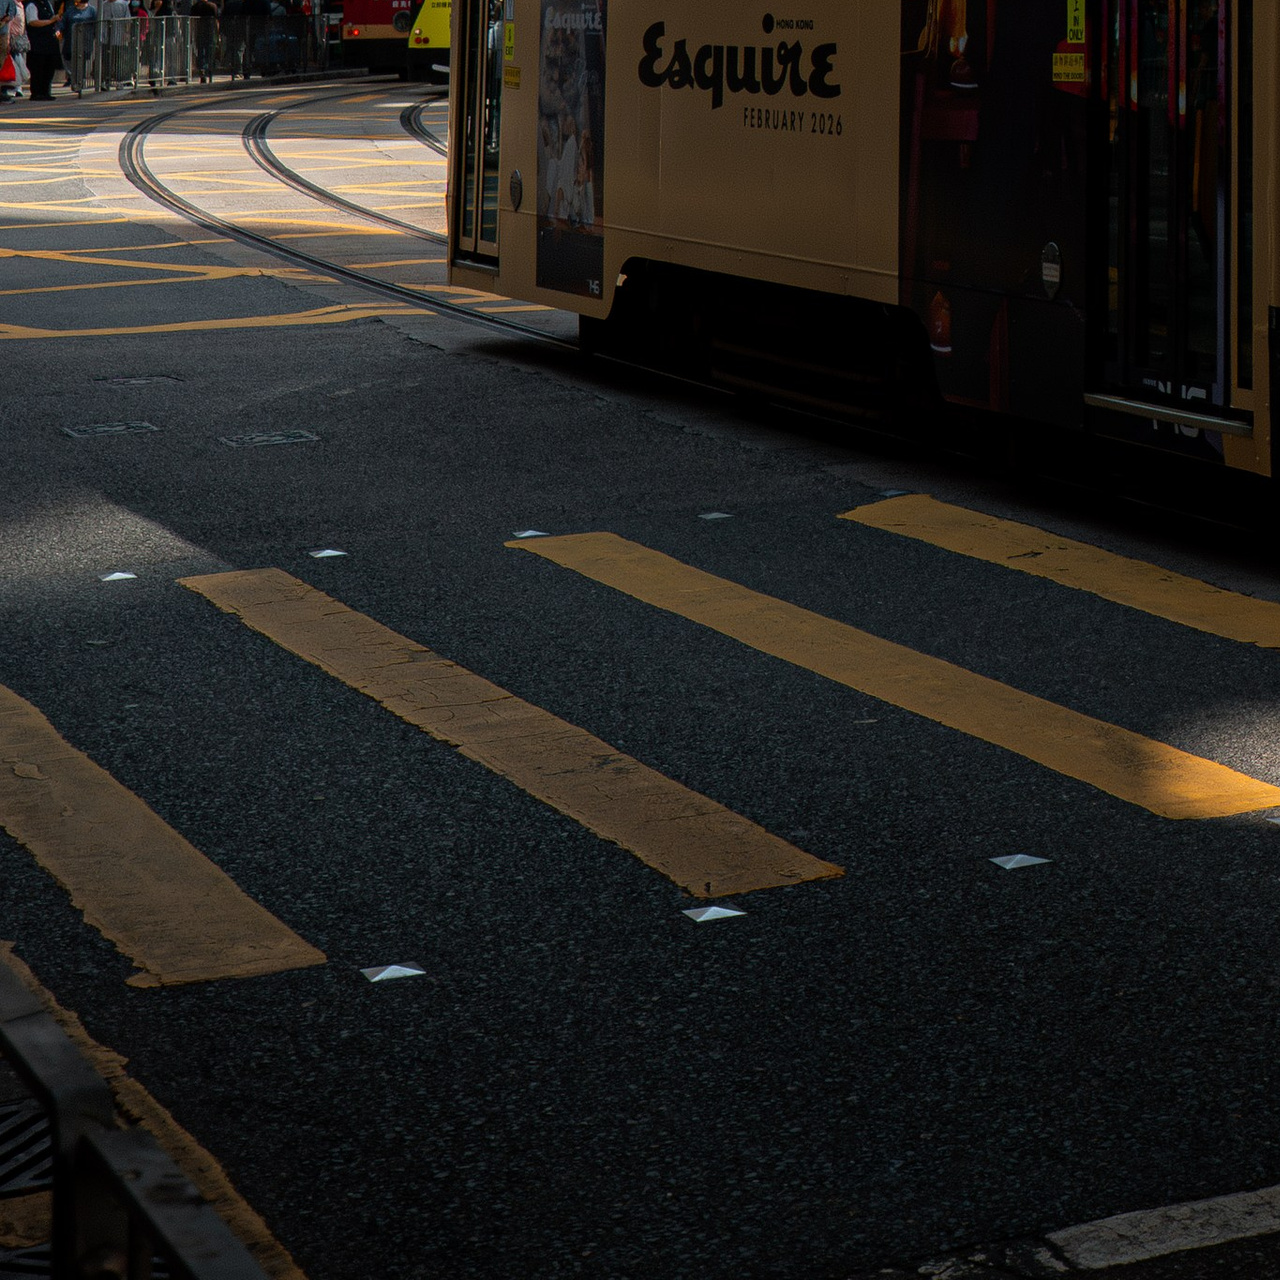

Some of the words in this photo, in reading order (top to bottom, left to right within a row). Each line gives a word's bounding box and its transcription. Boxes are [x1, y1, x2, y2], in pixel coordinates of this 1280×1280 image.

[545, 3, 603, 35] Esquire
[776, 19, 794, 29] HONG
[796, 19, 815, 30] KONG
[1073, 16, 1080, 27] IN
[1068, 28, 1084, 41] ONLY
[638, 13, 842, 110] Esquire
[743, 107, 804, 133] FEBRUARY
[810, 114, 844, 137] 2026
